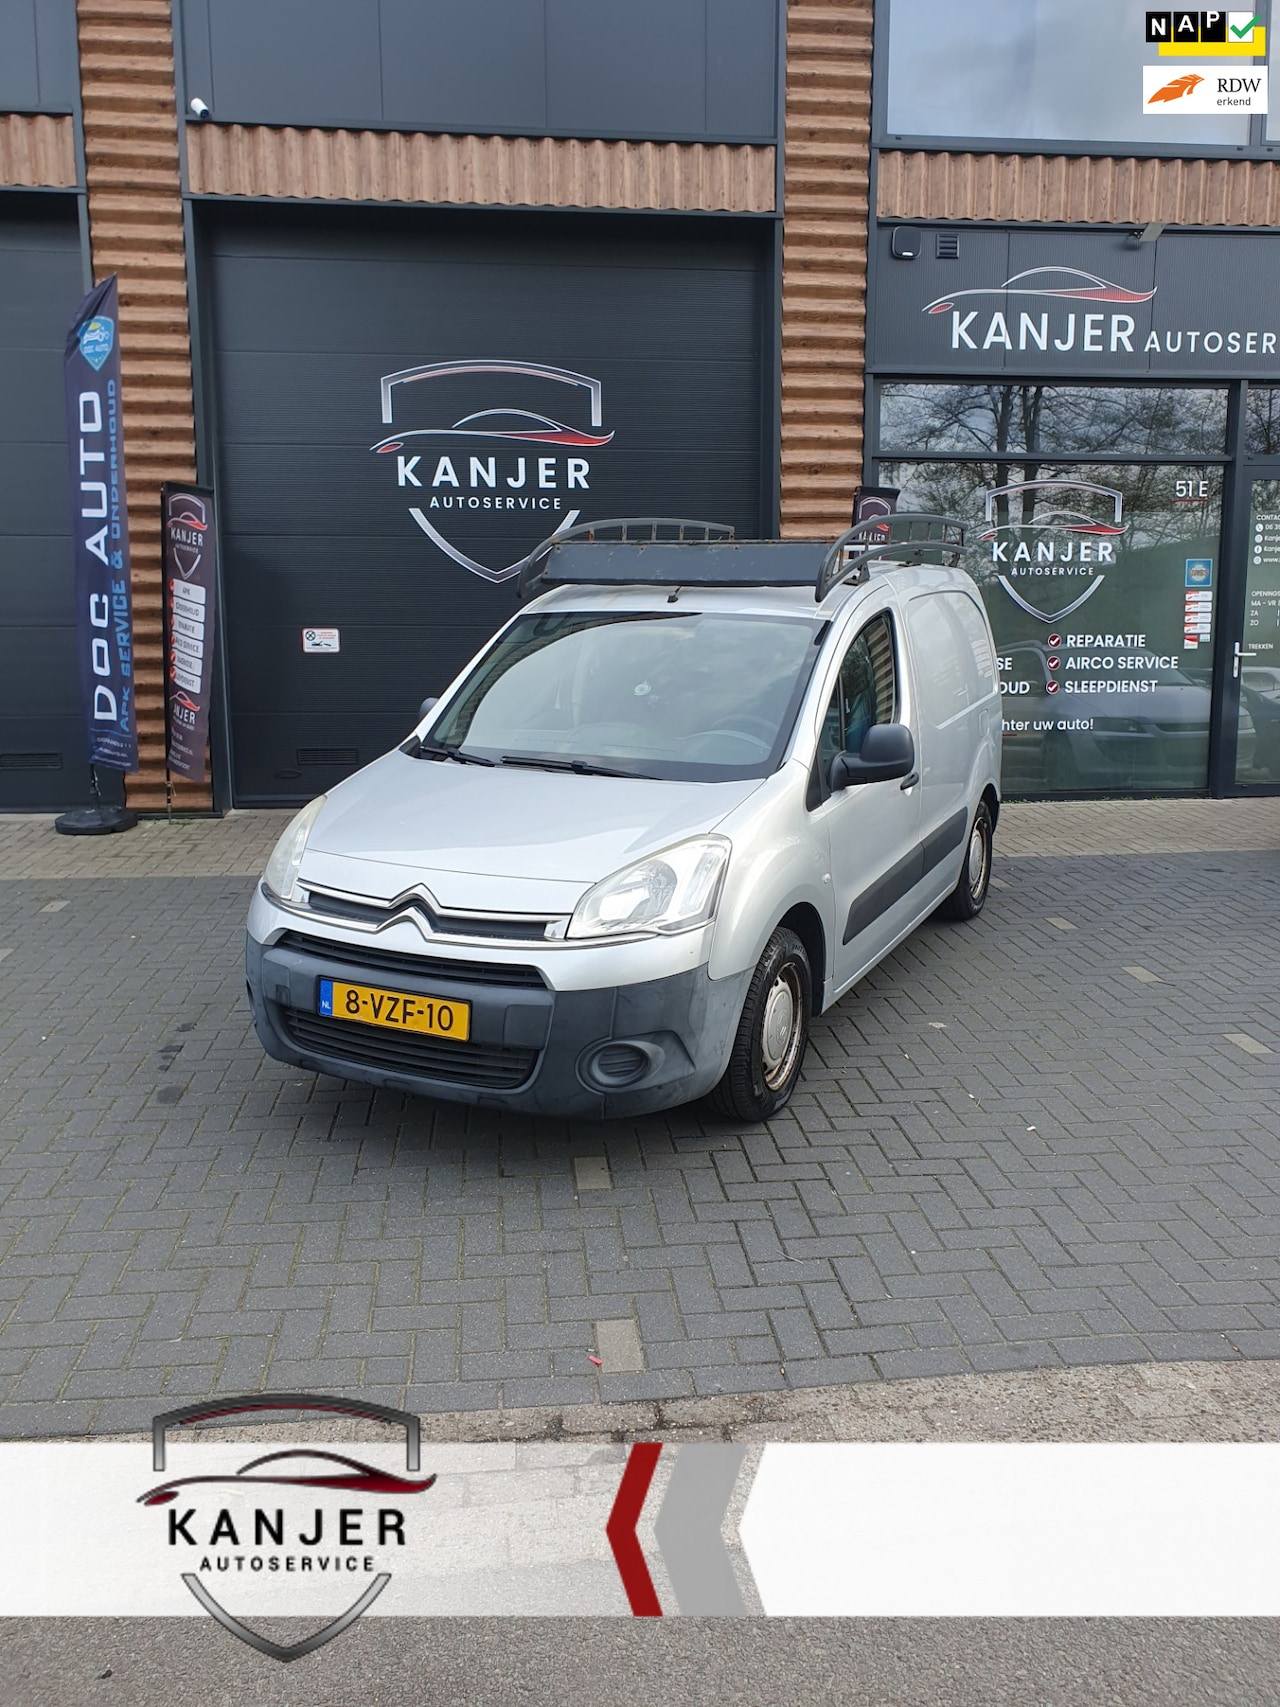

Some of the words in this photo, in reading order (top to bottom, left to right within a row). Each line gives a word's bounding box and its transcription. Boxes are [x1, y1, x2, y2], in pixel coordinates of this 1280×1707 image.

[951, 311, 1136, 352] KANJER
[1144, 331, 1277, 354] AUTOSER
[107, 379, 121, 539] ONDERHOUD
[79, 391, 109, 566] AUTO
[397, 456, 590, 489] KANJER
[1175, 481, 1192, 498] 51
[1199, 481, 1209, 497] E
[429, 496, 561, 510] AUTOSERVICE
[170, 527, 204, 547] KANJER
[110, 549, 123, 569] &
[992, 542, 1113, 561] KANJER
[1011, 567, 1094, 576] AUTOSERVICE
[111, 579, 131, 677] SERVICE
[1066, 634, 1146, 647] REPARATIE
[89, 593, 118, 721] DOC
[1065, 657, 1114, 670] AIRCO
[1117, 656, 1179, 670] SERVICE
[1064, 680, 1158, 693] SLEEPDIENST
[119, 686, 131, 732] APK
[1033, 721, 1054, 731] uw
[1057, 718, 1094, 730] auto!
[321, 1000, 331, 1010] NL
[345, 989, 454, 1031] 8-VZF-10
